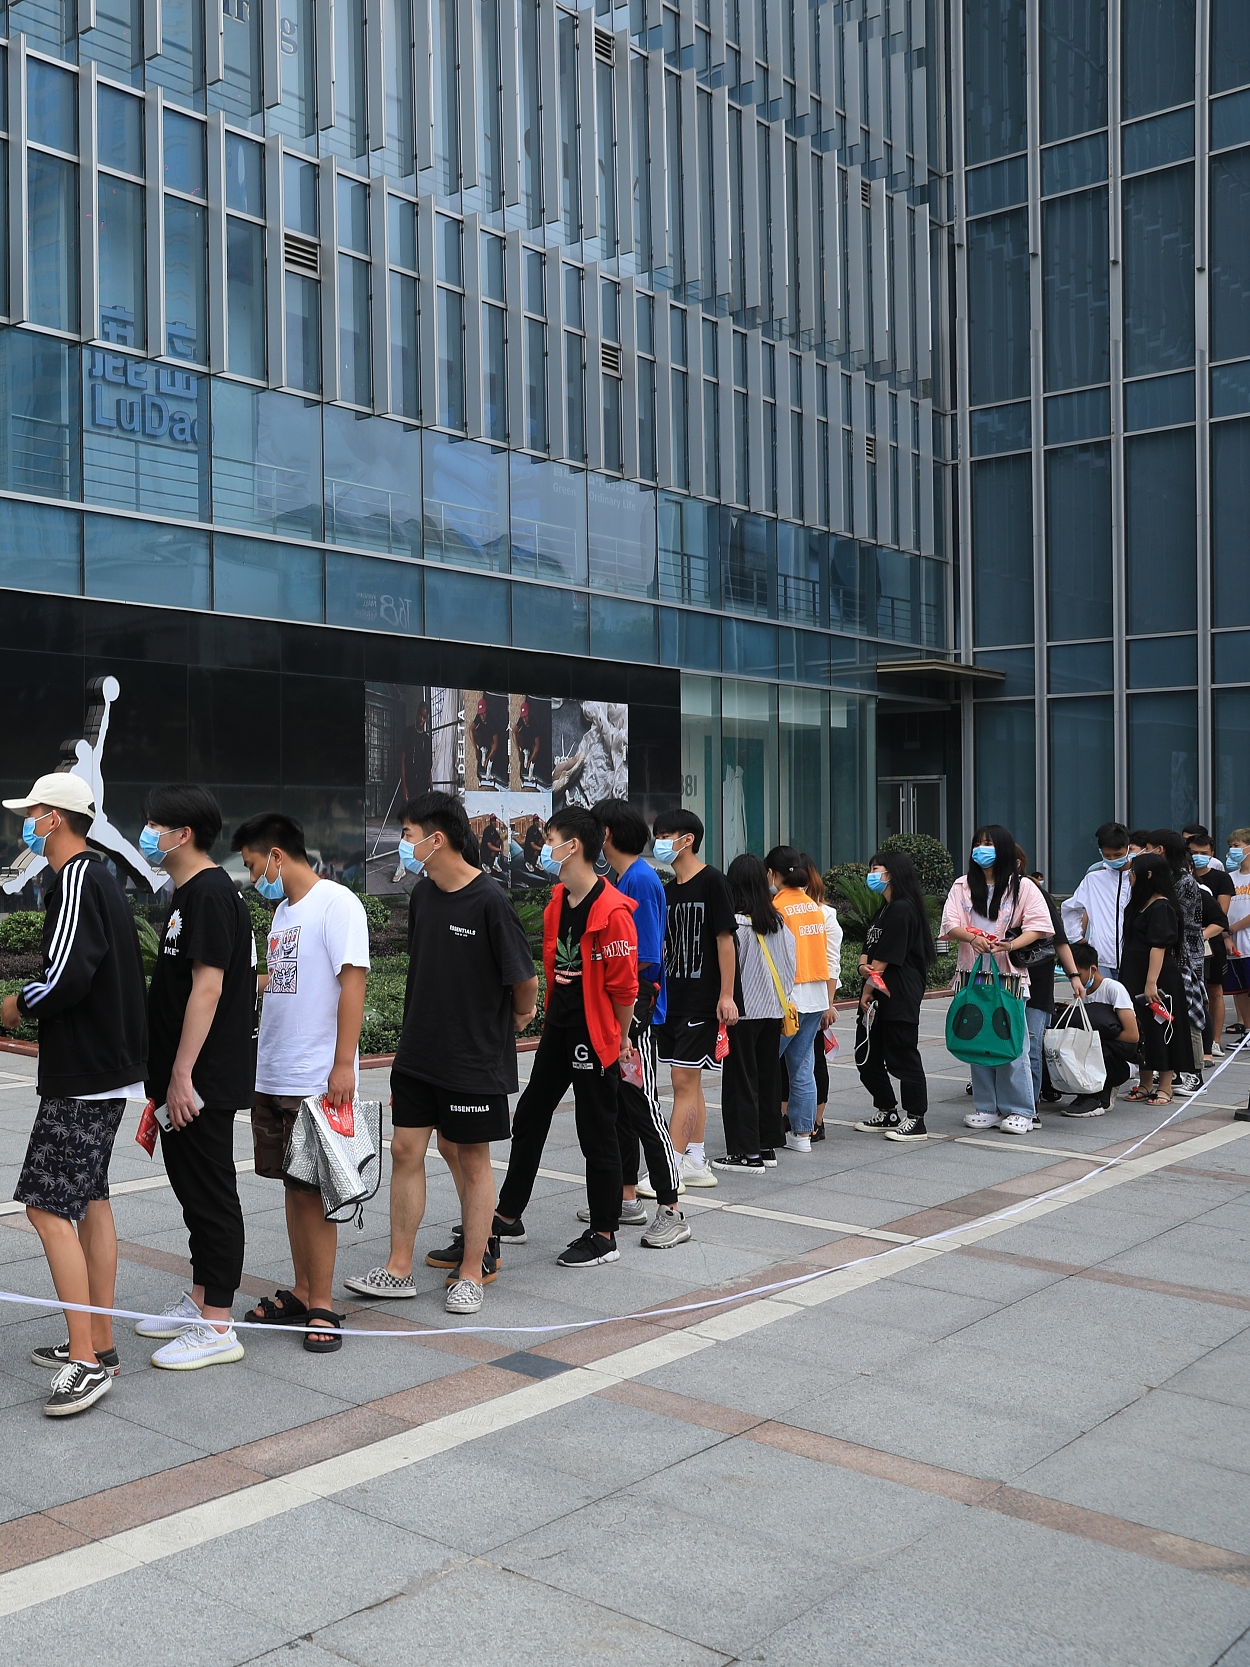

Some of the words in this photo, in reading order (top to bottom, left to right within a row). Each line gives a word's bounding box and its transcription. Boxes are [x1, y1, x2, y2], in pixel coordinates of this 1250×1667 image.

[553, 482, 576, 496] Green
[589, 490, 621, 509] Ordinary
[623, 499, 636, 511] Life
[457, 709, 466, 774] DELTA
[575, 1044, 588, 1061] G
